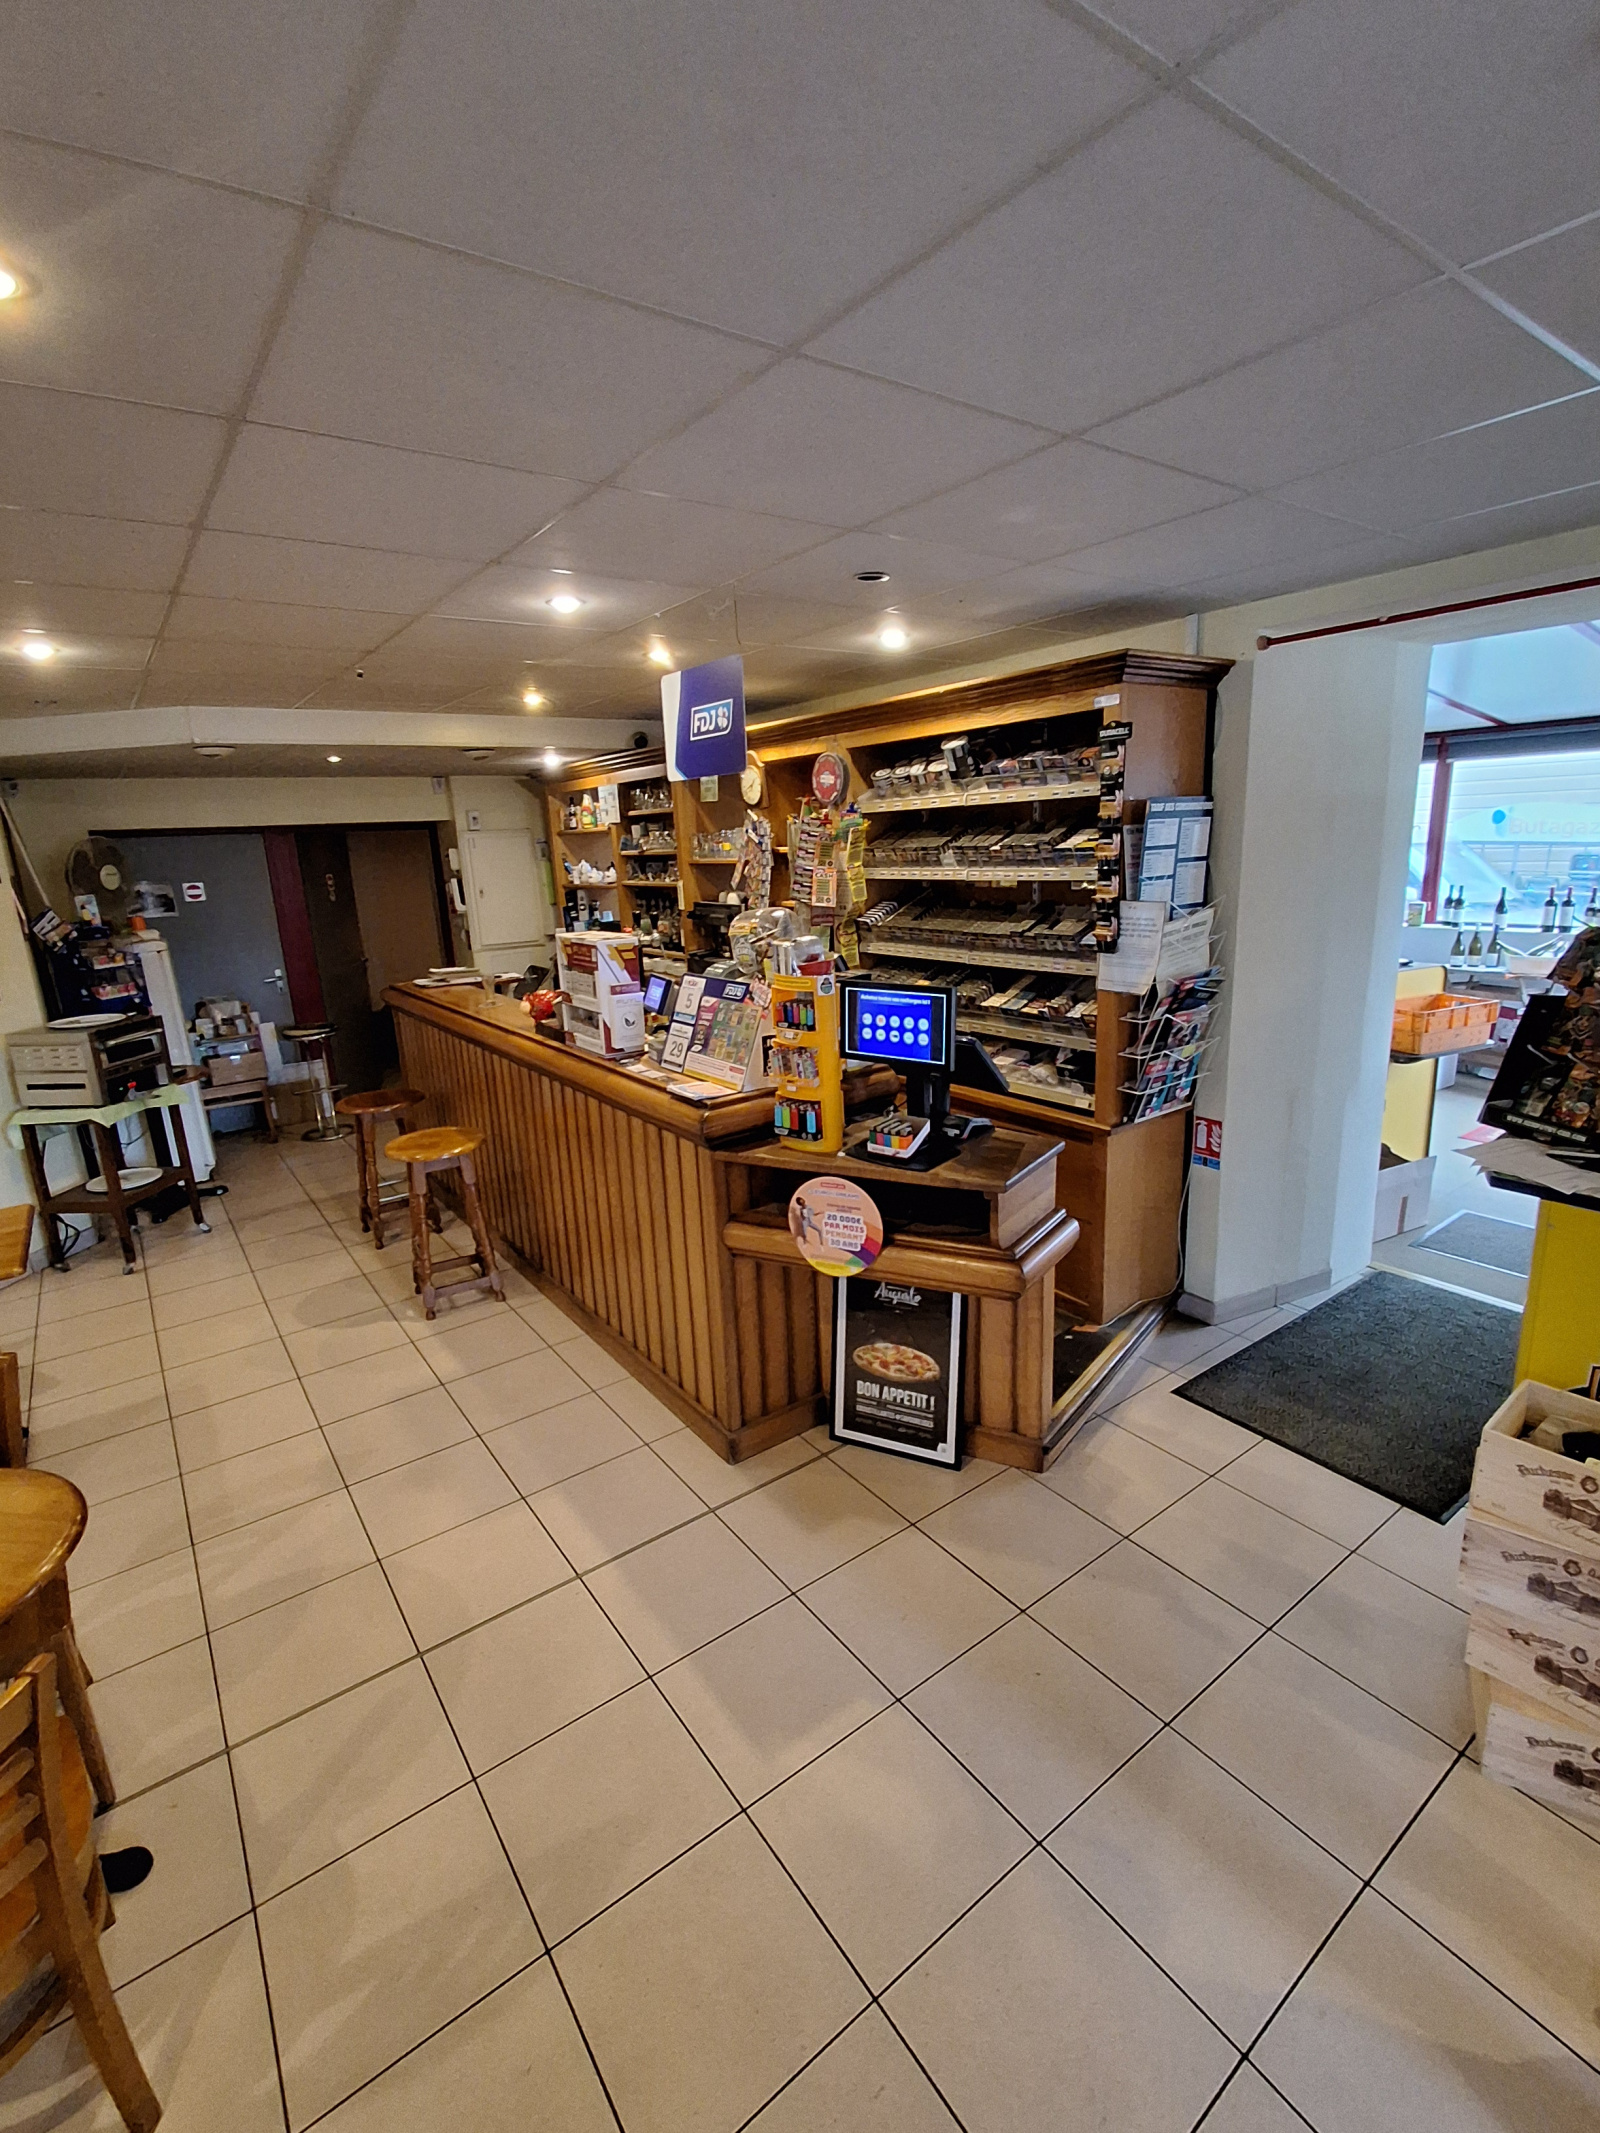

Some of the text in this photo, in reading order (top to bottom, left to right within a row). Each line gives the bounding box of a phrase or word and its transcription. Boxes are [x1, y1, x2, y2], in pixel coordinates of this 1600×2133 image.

[694, 709, 716, 734] FDJ
[669, 1040, 684, 1058] 29
[826, 1213, 837, 1221] 20
[824, 1221, 865, 1233] PAR MOIS
[825, 1230, 864, 1241] PENDANT
[830, 1238, 859, 1249] 30 ANS
[856, 1379, 880, 1398] BON
[882, 1385, 928, 1409] APPETIT
[930, 1396, 936, 1411] !
